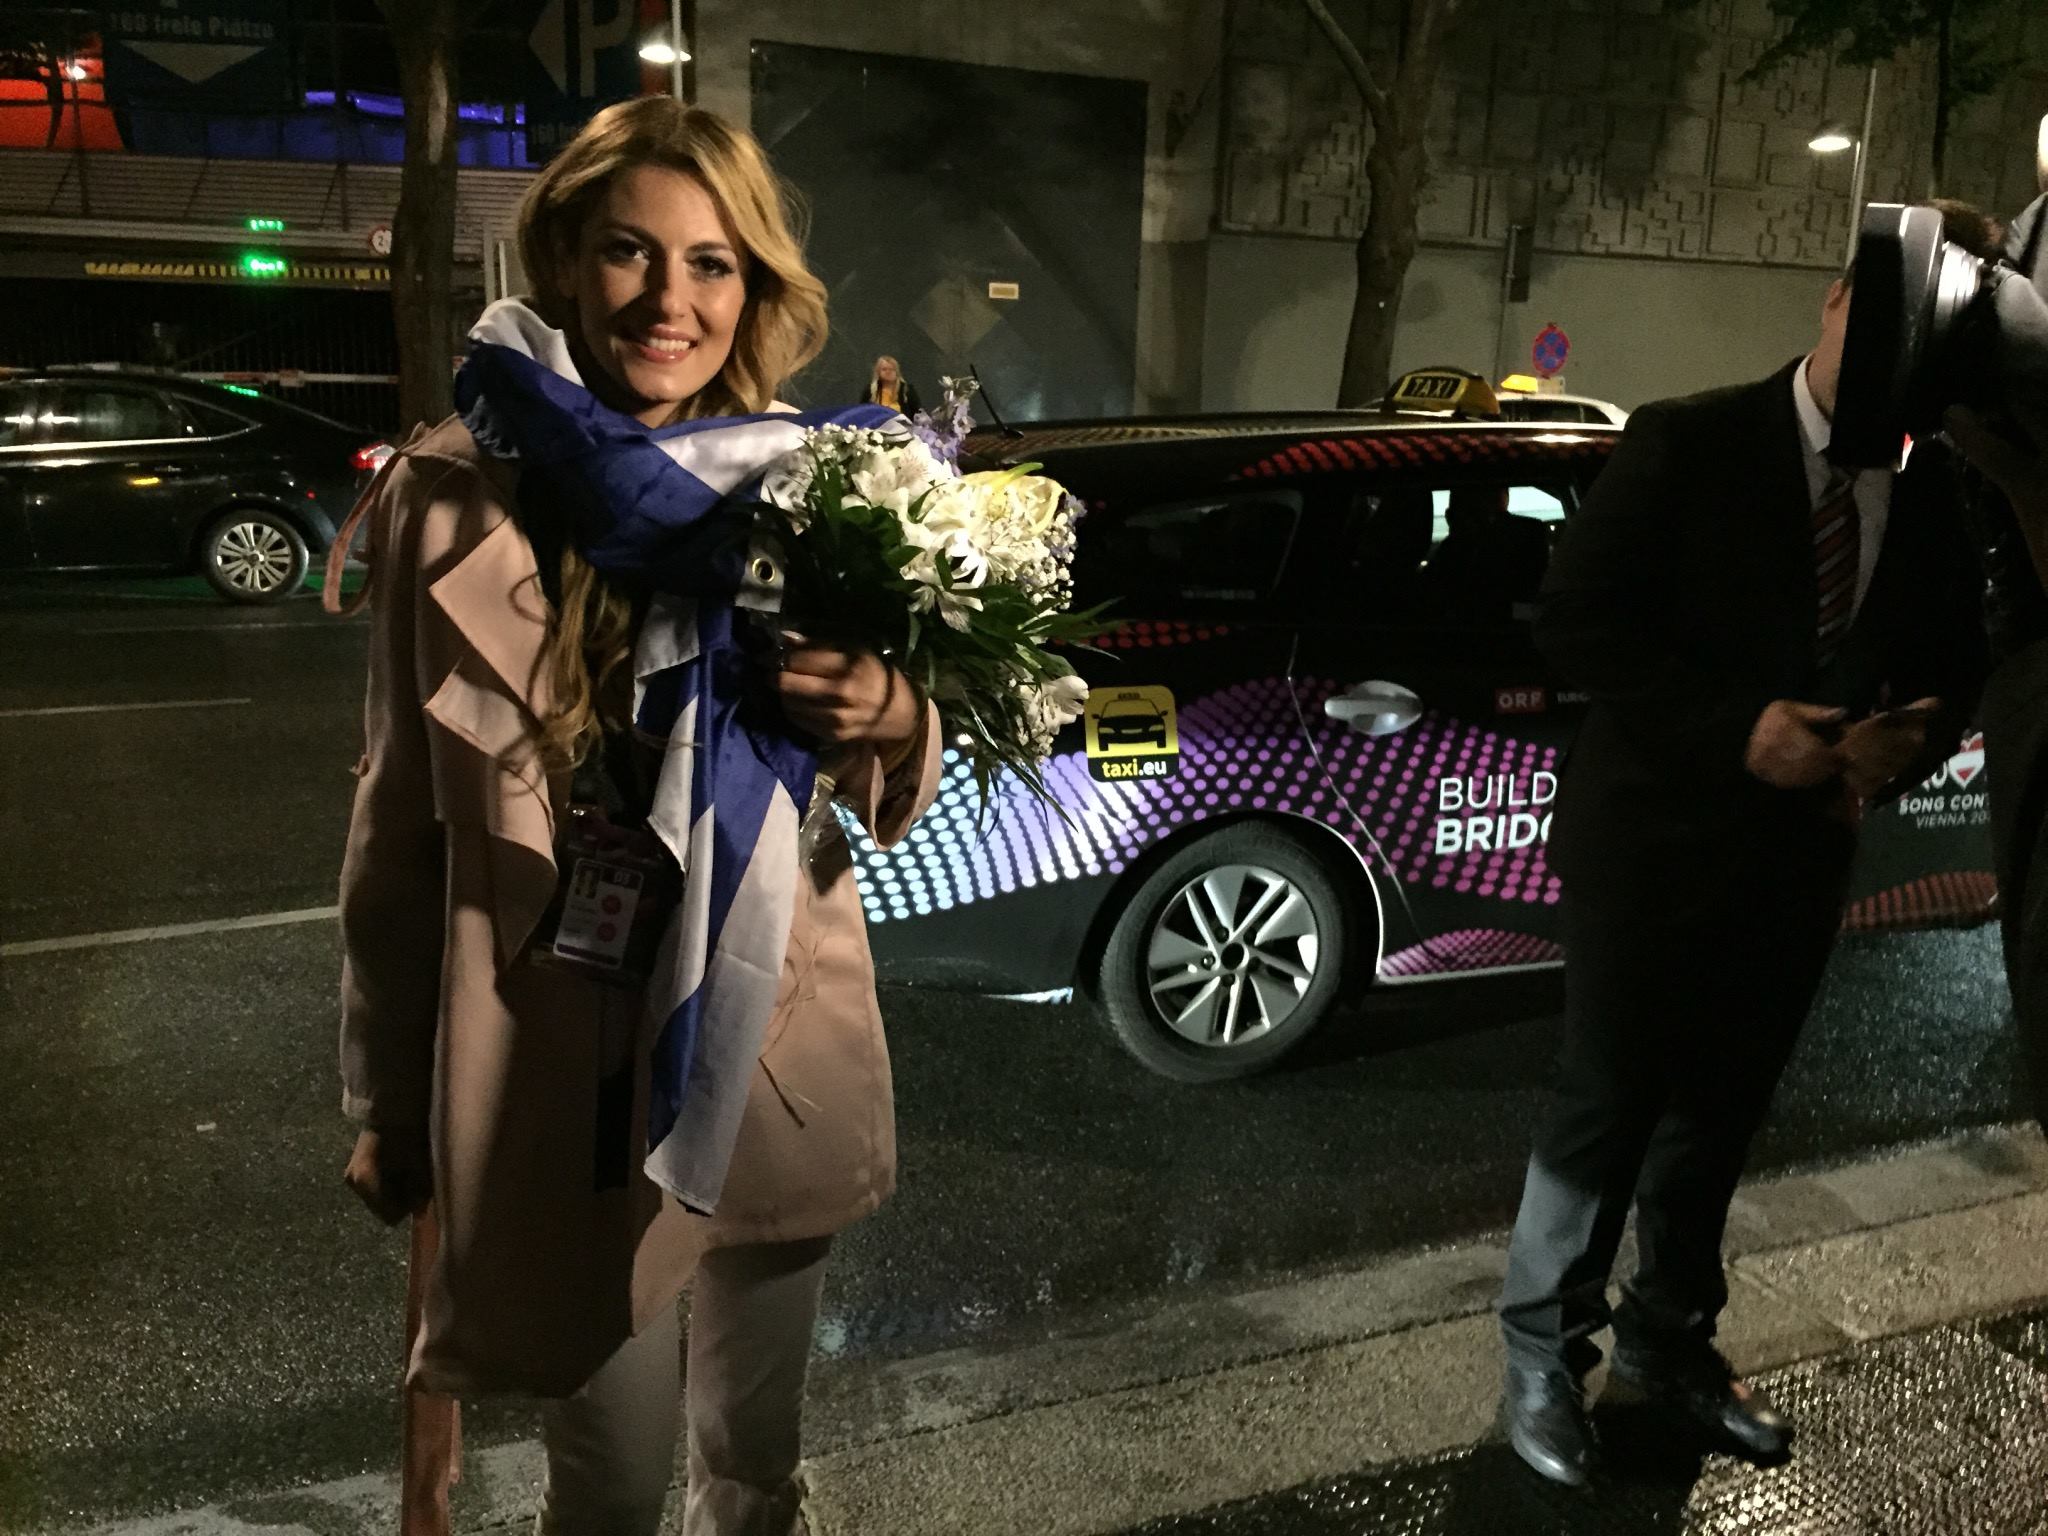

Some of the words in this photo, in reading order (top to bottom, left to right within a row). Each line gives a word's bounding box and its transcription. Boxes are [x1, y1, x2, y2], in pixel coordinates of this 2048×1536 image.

[1411, 378, 1454, 397] TAXI
[1498, 691, 1542, 709] ORF
[1101, 758, 1167, 778] taxi.eu
[1438, 771, 1558, 812] BUILD
[1950, 793, 1990, 811] CON
[1916, 813, 1966, 829] VIENNA
[1970, 810, 1990, 825] 20
